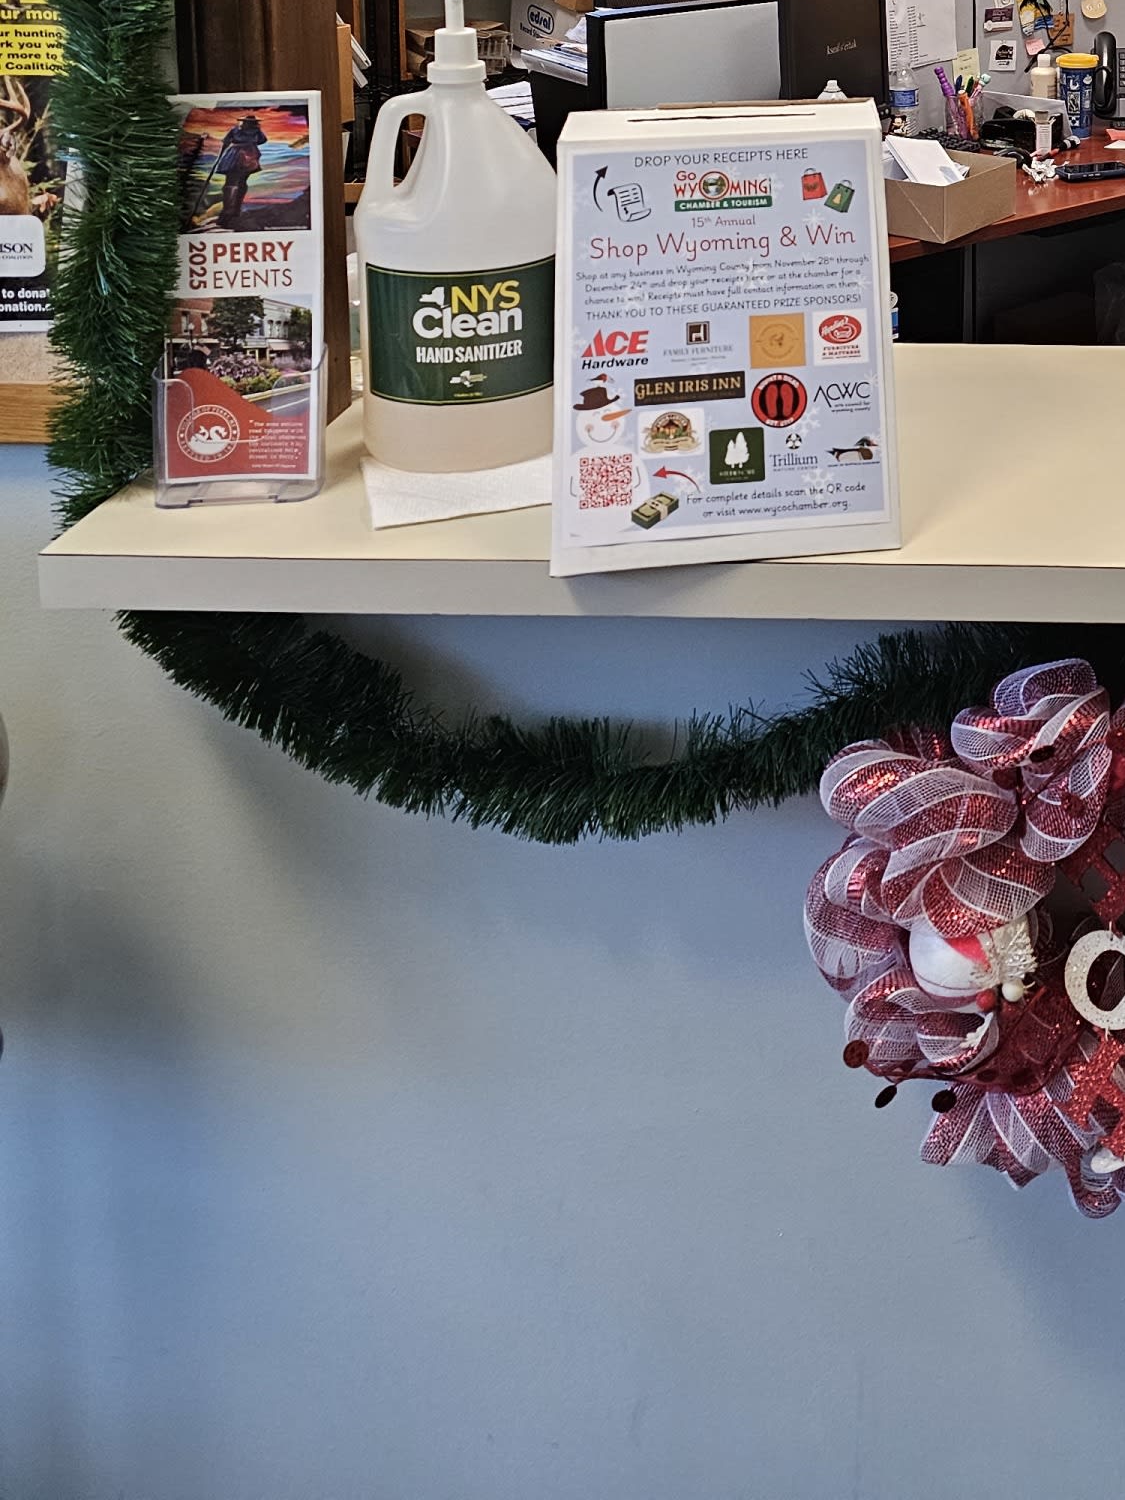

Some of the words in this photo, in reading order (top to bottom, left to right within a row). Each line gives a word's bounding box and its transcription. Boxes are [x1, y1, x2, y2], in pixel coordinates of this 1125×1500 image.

[7, 52, 41, 60] more
[46, 51, 58, 61] to
[18, 42, 41, 50] you
[634, 156, 671, 168] DROP
[673, 153, 710, 166] YOUR
[713, 150, 772, 164] RECEIPTS
[776, 148, 809, 160] HERE
[676, 170, 697, 181] Go
[679, 201, 721, 210] CHAMBER
[723, 200, 729, 208] &
[731, 198, 768, 208] TOURISM
[692, 216, 713, 228] 15th
[714, 214, 756, 227] Annual
[213, 241, 294, 264] PERRY
[590, 237, 648, 265] Shop
[657, 231, 770, 261] Wyoming
[780, 226, 798, 247] &
[806, 224, 856, 247] Win
[188, 241, 207, 290] 2025
[576, 271, 598, 281] Shop
[600, 272, 609, 280] at
[629, 268, 664, 278] business
[666, 267, 675, 275] in
[676, 264, 717, 276] Wyoming
[720, 261, 750, 272] County
[774, 259, 817, 268] November
[836, 254, 870, 266] through
[213, 268, 292, 290] EVENTS
[585, 283, 627, 293] December
[650, 280, 666, 289] and
[668, 279, 688, 290] drop
[689, 278, 709, 288] your
[788, 270, 801, 279] the
[803, 269, 839, 278] chamber
[841, 267, 853, 279] for
[2, 288, 15, 299] to
[17, 288, 54, 299] donat
[451, 280, 520, 314] NYS
[585, 295, 614, 305] chance
[647, 291, 682, 302] Receipts
[683, 289, 704, 298] must
[706, 287, 725, 296] have
[727, 286, 742, 298] full
[744, 285, 774, 294] contact
[776, 282, 825, 295] information
[585, 311, 623, 321] THANK
[625, 308, 646, 318] YOU
[650, 307, 664, 317] TO
[666, 304, 699, 315] THESE
[701, 299, 771, 313] GUARANTEED
[773, 297, 801, 308] PRIZE
[803, 294, 862, 305] SPONSORS!
[412, 306, 523, 339] Clean
[416, 346, 454, 364] HAND
[454, 339, 523, 363] SANITIZER
[581, 328, 649, 358] ACE
[581, 357, 649, 370] Hardware
[635, 381, 675, 400] GLEN
[679, 379, 709, 394] IRIS
[712, 376, 742, 392] INN
[769, 453, 818, 468] Trillium
[687, 493, 702, 504] For
[706, 490, 748, 505] complete
[751, 488, 782, 500] details
[784, 488, 806, 497] scan
[809, 485, 824, 496] the
[826, 484, 842, 495] QR
[844, 482, 866, 493] code
[703, 509, 714, 517] or
[716, 506, 736, 517] visit
